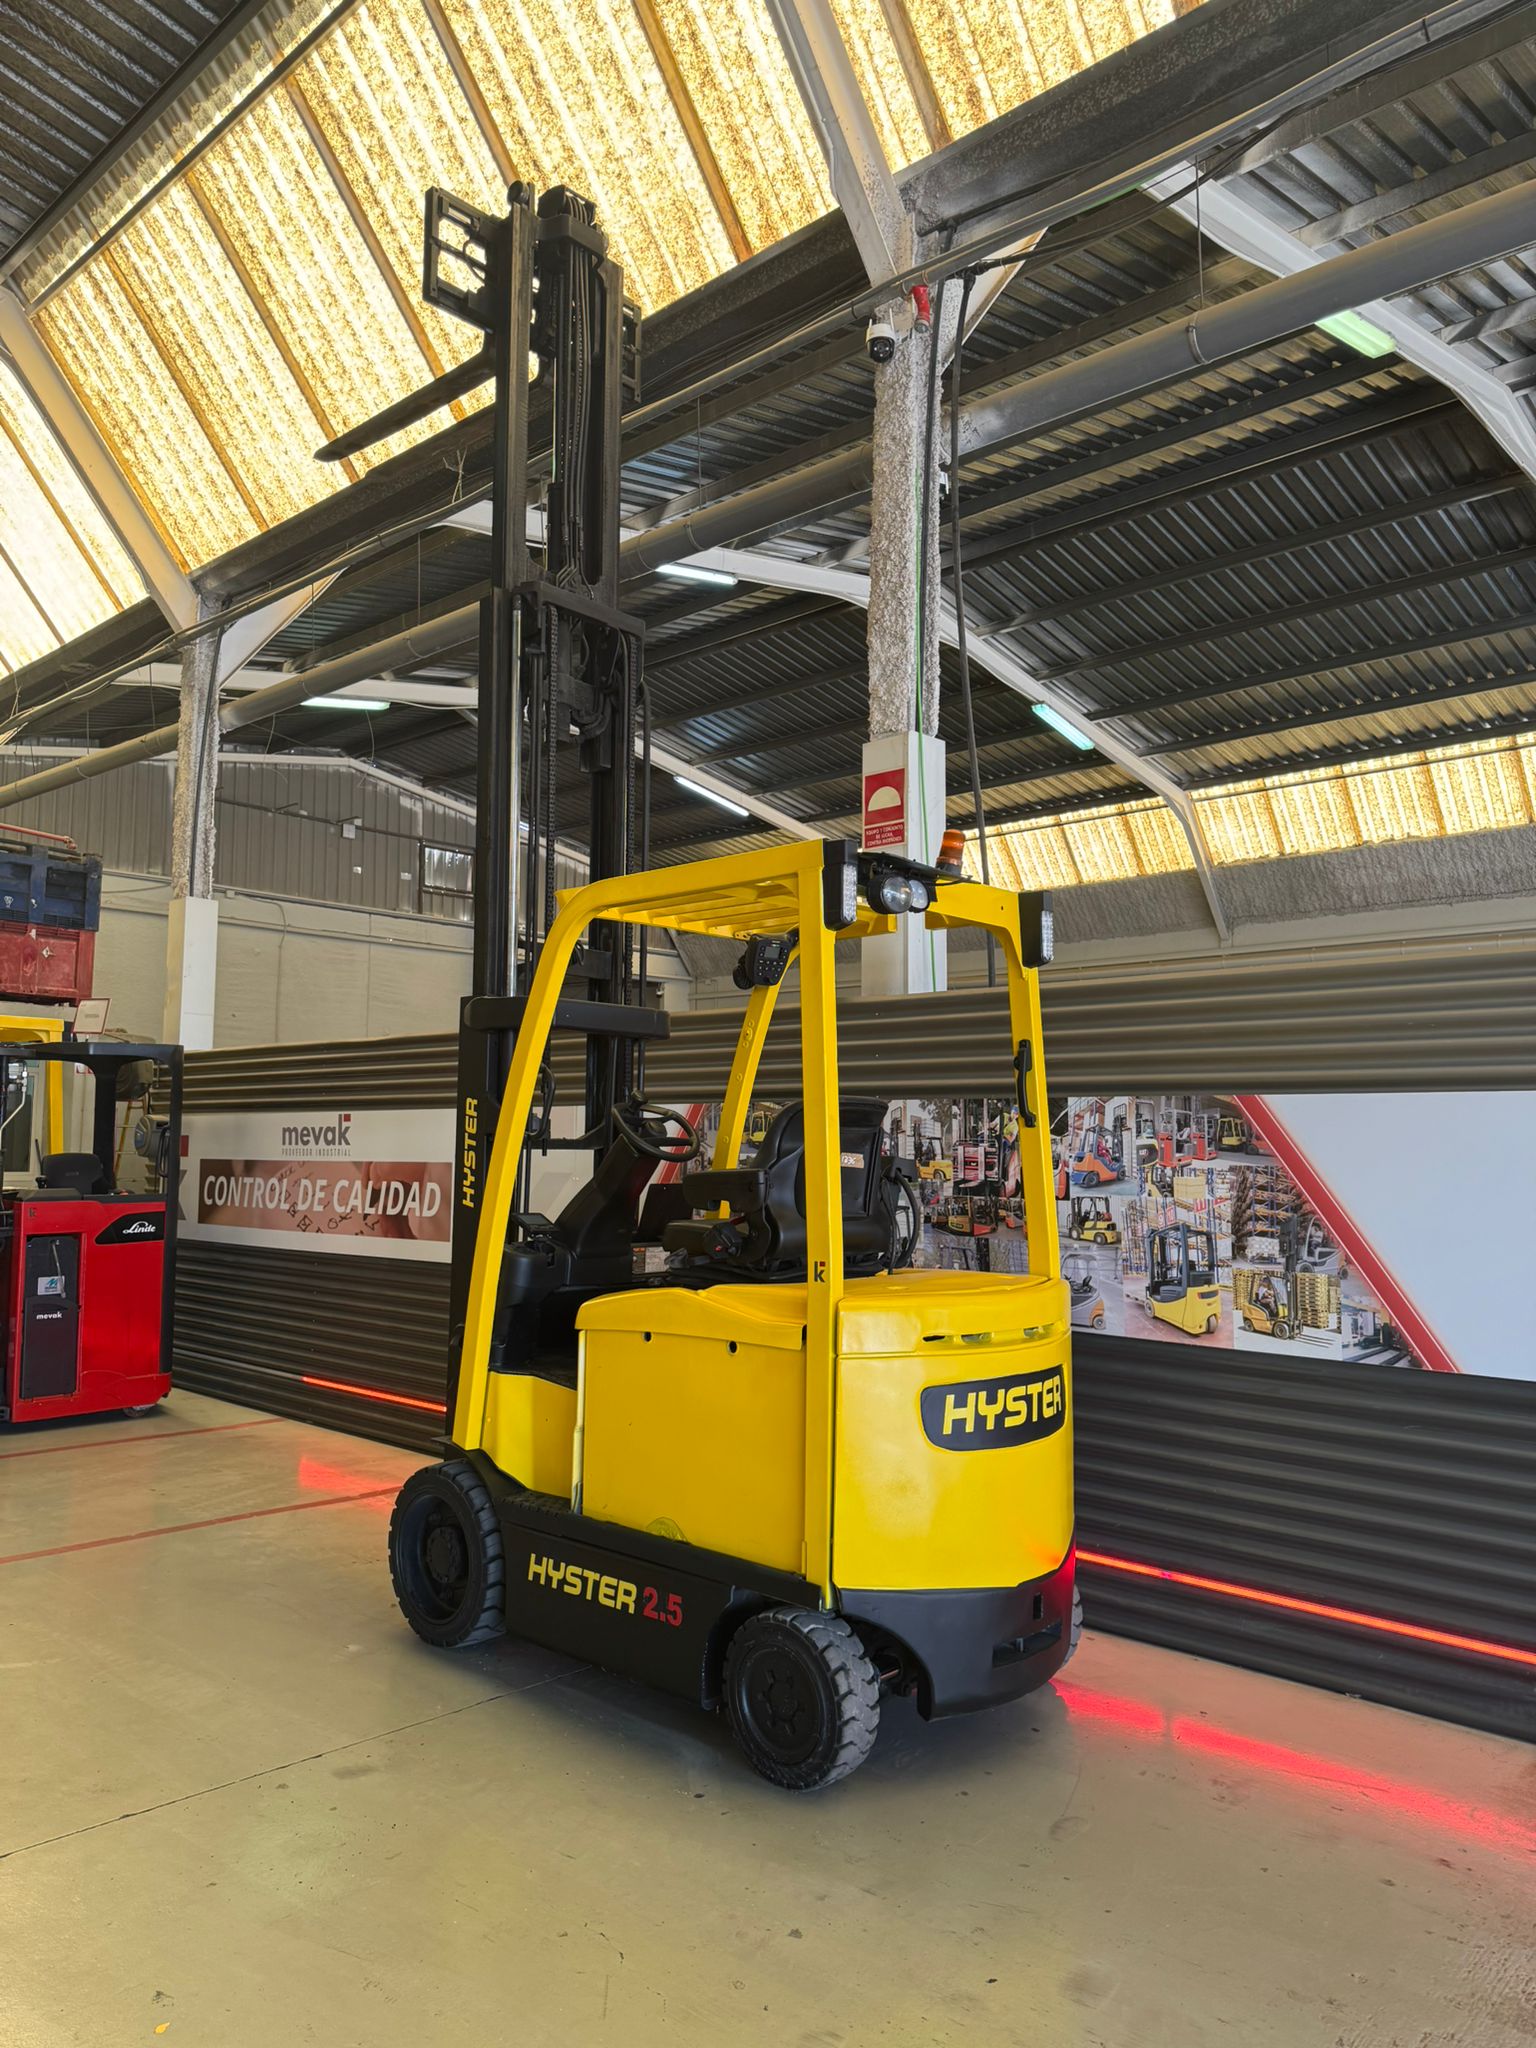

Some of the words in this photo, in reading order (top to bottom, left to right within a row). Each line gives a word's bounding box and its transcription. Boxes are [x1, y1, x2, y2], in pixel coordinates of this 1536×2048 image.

[282, 1113, 351, 1146] mevak
[462, 1098, 478, 1208] HYSTER
[203, 1175, 290, 1210] CONTROL
[296, 1178, 328, 1212] DE
[333, 1179, 441, 1217] CALIDAD
[122, 1221, 156, 1234] Linde
[36, 1311, 62, 1320] mevak
[942, 1374, 1062, 1435] HYSTER
[527, 1553, 637, 1614] HYSTER
[643, 1586, 683, 1627] 2.5
